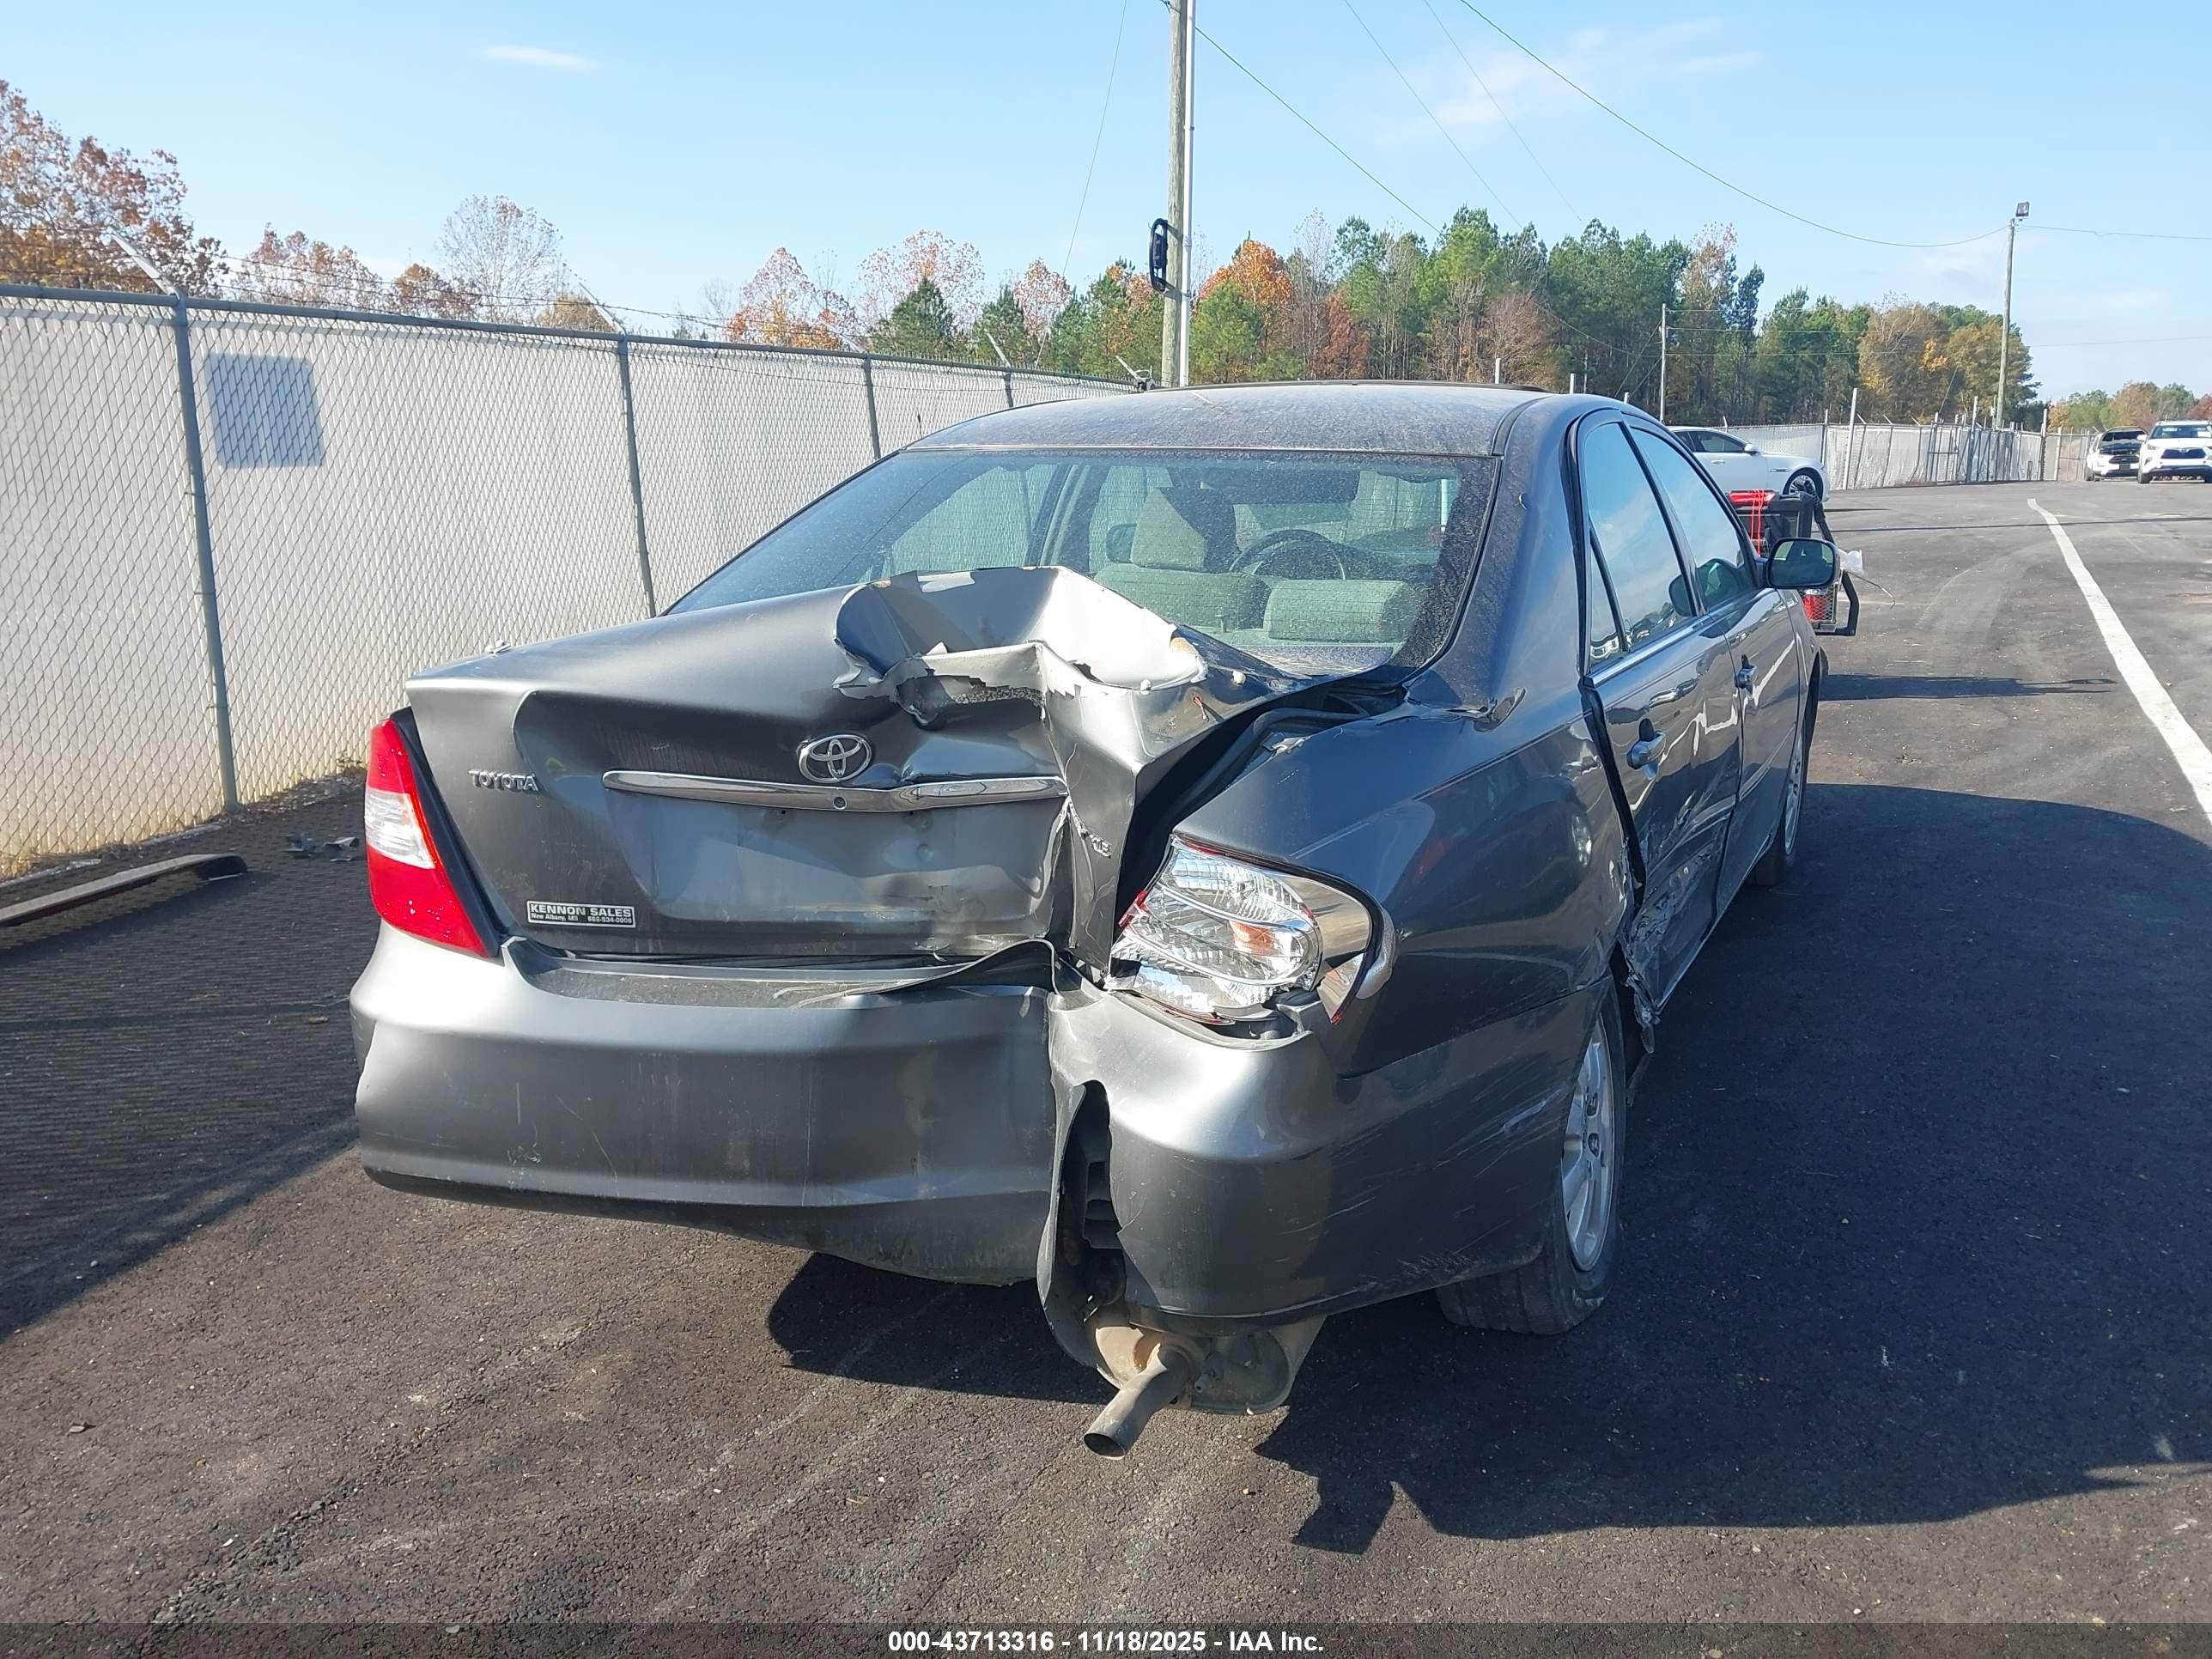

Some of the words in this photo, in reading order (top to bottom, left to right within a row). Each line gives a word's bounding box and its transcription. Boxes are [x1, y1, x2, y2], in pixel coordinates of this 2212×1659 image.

[468, 769, 539, 791] TOYOTA
[531, 904, 586, 915] KENNON
[590, 908, 631, 917] SALES
